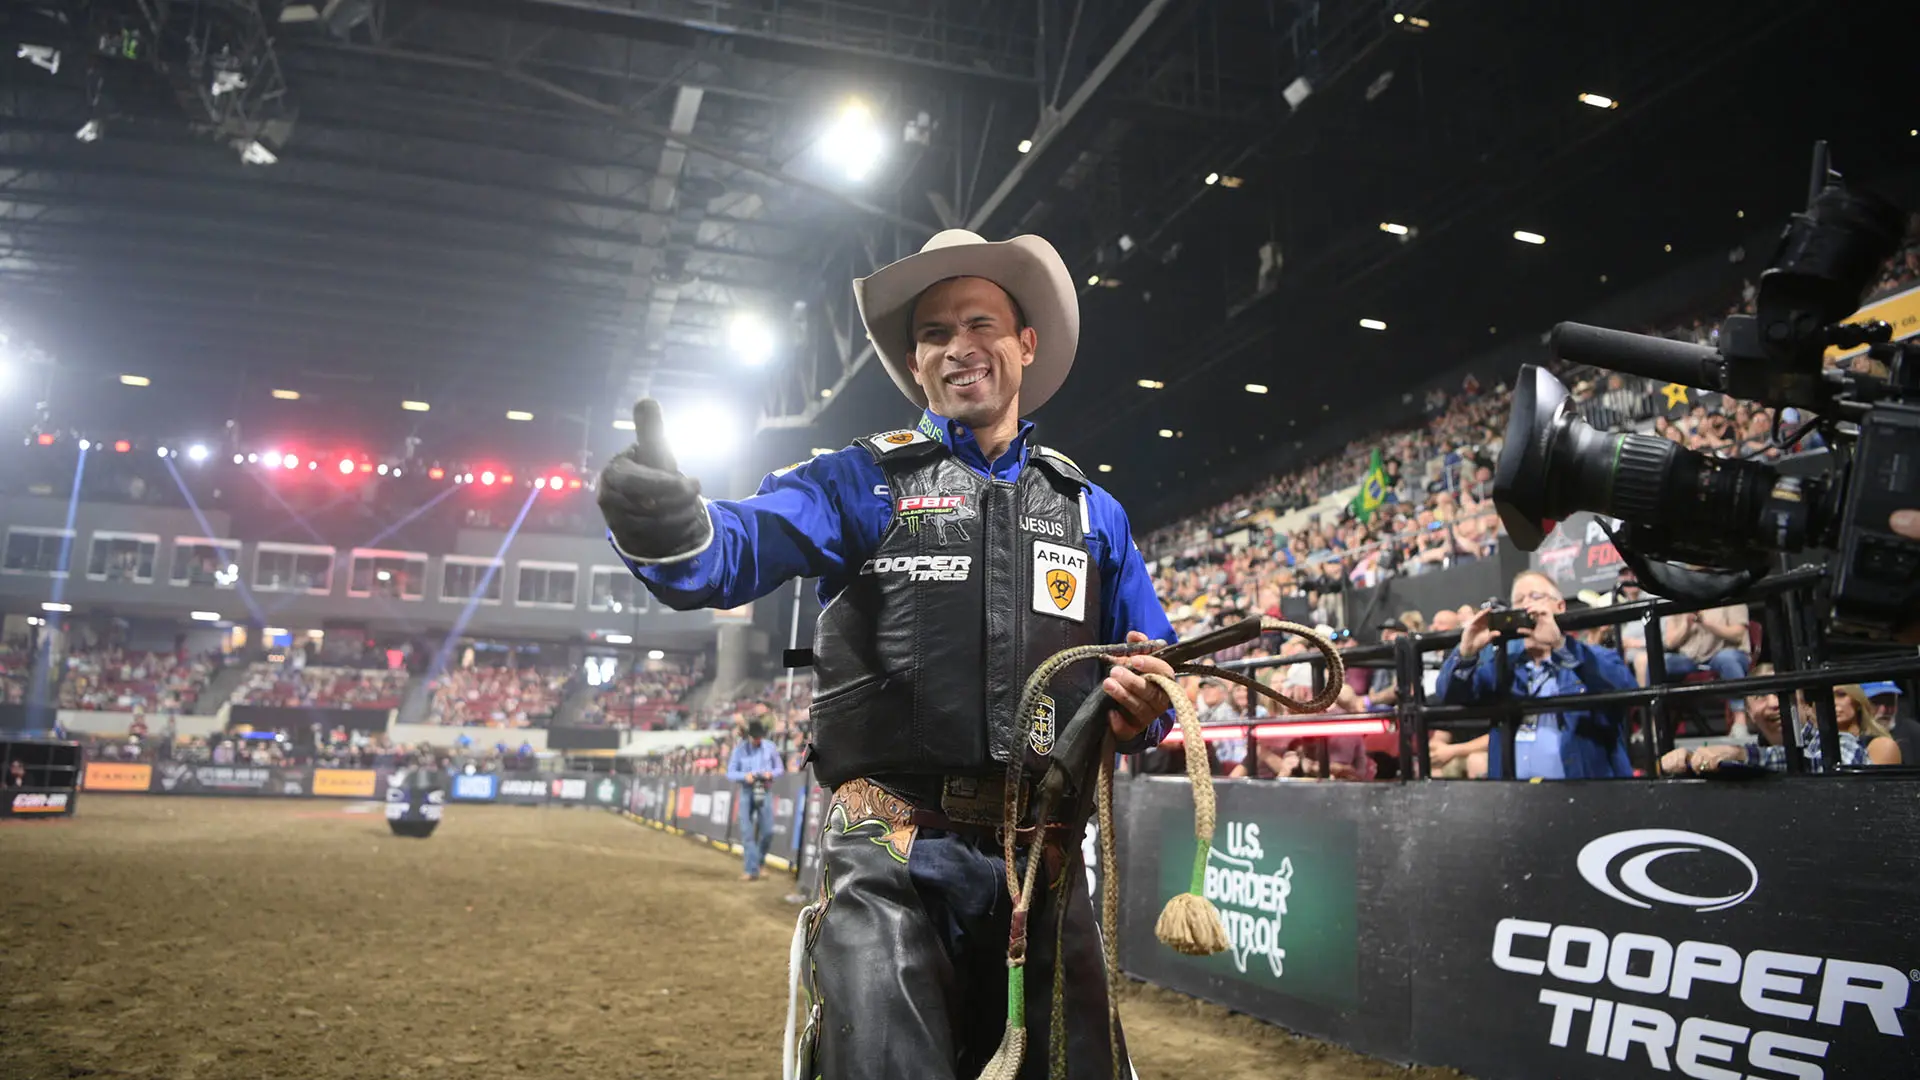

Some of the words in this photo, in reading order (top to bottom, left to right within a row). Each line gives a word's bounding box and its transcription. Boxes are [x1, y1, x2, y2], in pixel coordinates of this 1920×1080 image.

[901, 497, 961, 510] PBR
[1022, 516, 1064, 537] JESUS
[860, 556, 972, 575] COOPER
[1037, 549, 1085, 569] ARIAT
[909, 570, 969, 581] TIRES
[1227, 821, 1264, 859] U.S.
[1204, 865, 1291, 915] BORDER
[1213, 907, 1286, 959] ATROL
[1492, 918, 1910, 1036] COOPER
[1539, 989, 1829, 1080] TIRES
